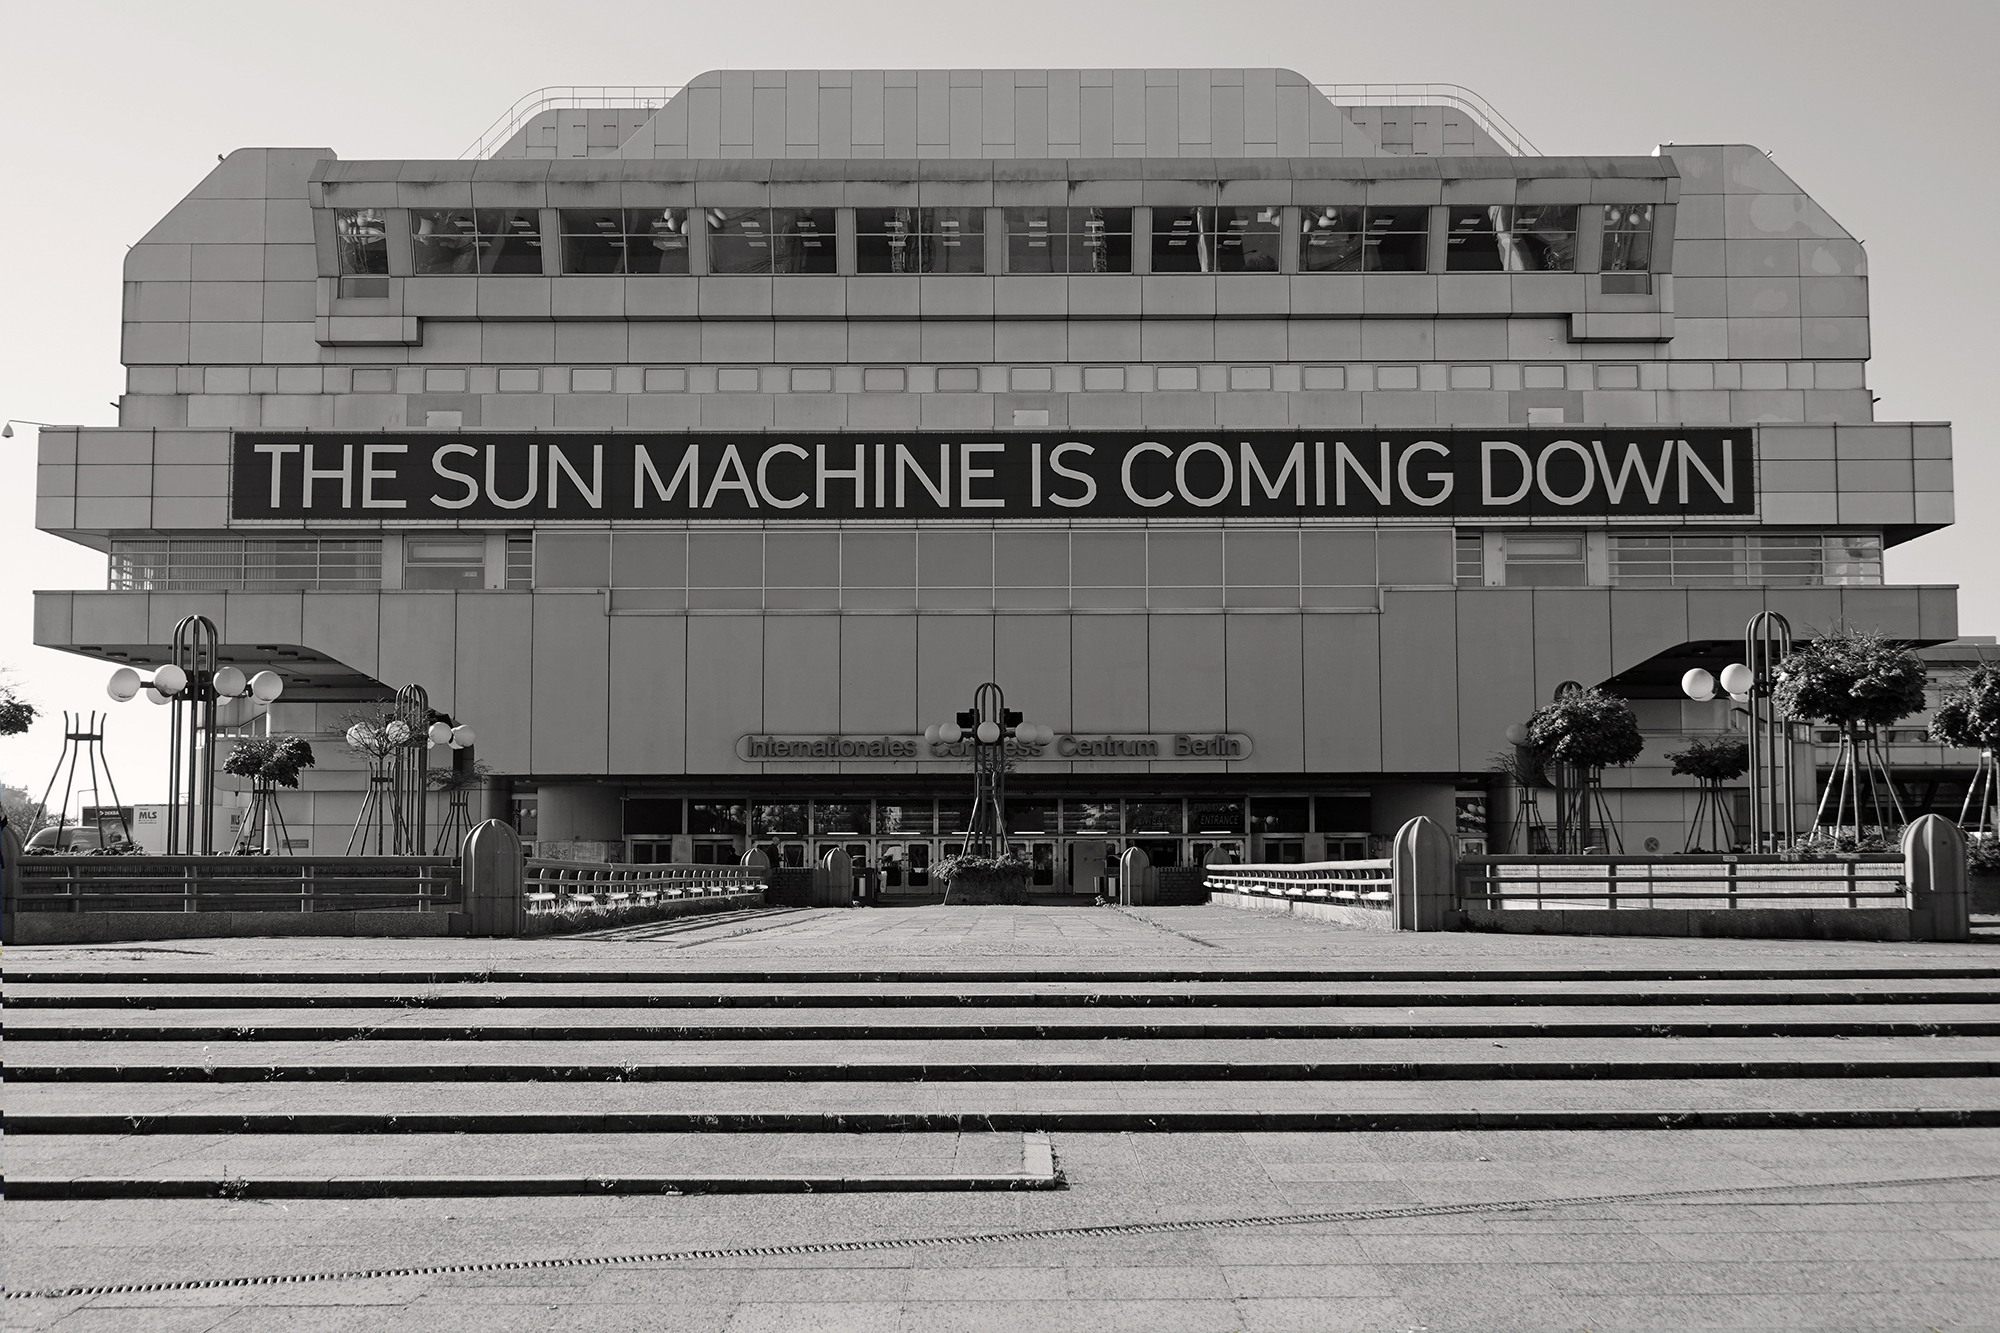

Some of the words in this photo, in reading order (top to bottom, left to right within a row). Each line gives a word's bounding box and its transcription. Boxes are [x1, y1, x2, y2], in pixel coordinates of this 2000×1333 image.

[254, 443, 408, 509] THE
[429, 443, 604, 510] SUN
[634, 443, 1006, 509] MACHINE
[1031, 442, 1098, 508] IS
[1121, 442, 1454, 508] COMING
[1479, 439, 1736, 507] DOWN
[747, 736, 918, 758] Internationales
[1057, 735, 1159, 757] Centrum
[1174, 735, 1241, 757] Berlin
[139, 811, 158, 819] MLS
[1200, 815, 1239, 825] ENTRANCE
